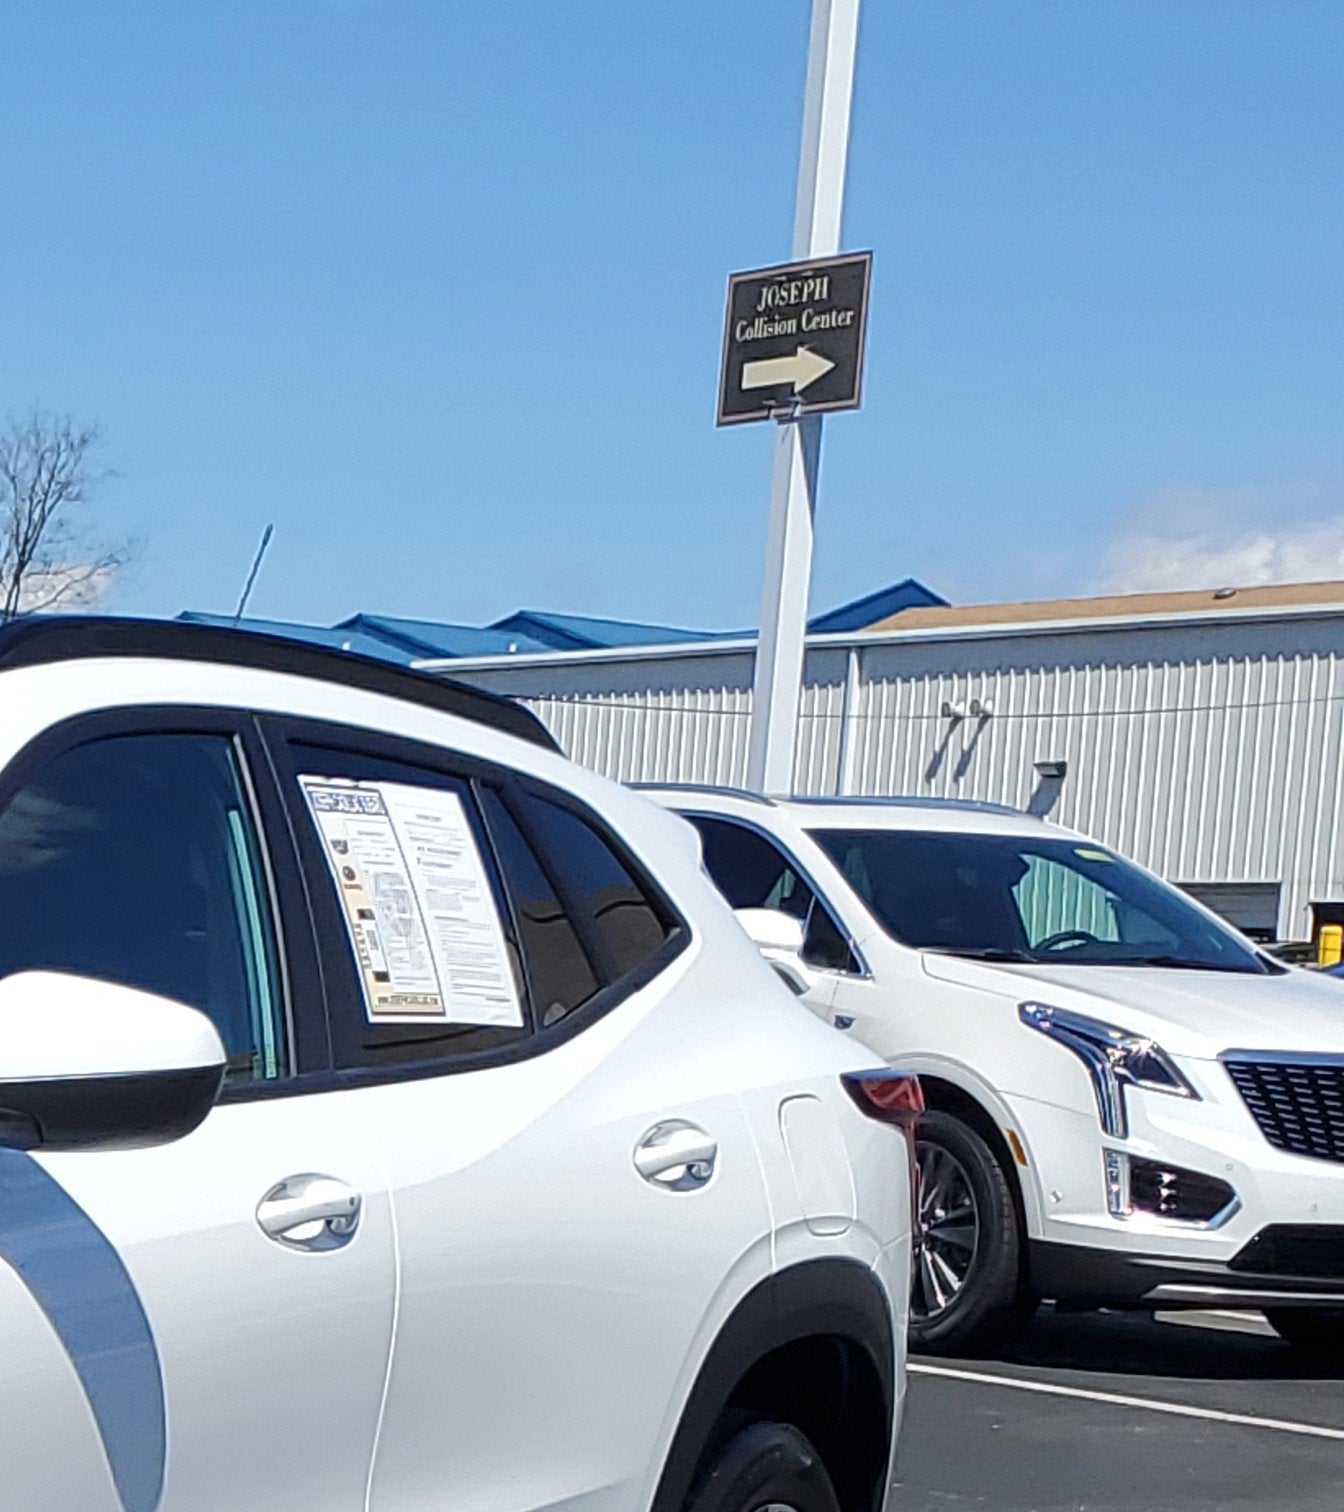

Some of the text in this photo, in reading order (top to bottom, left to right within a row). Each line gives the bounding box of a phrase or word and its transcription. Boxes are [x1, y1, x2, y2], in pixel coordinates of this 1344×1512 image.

[757, 275, 830, 312] JOSEPH
[735, 309, 855, 342] Collision Center
